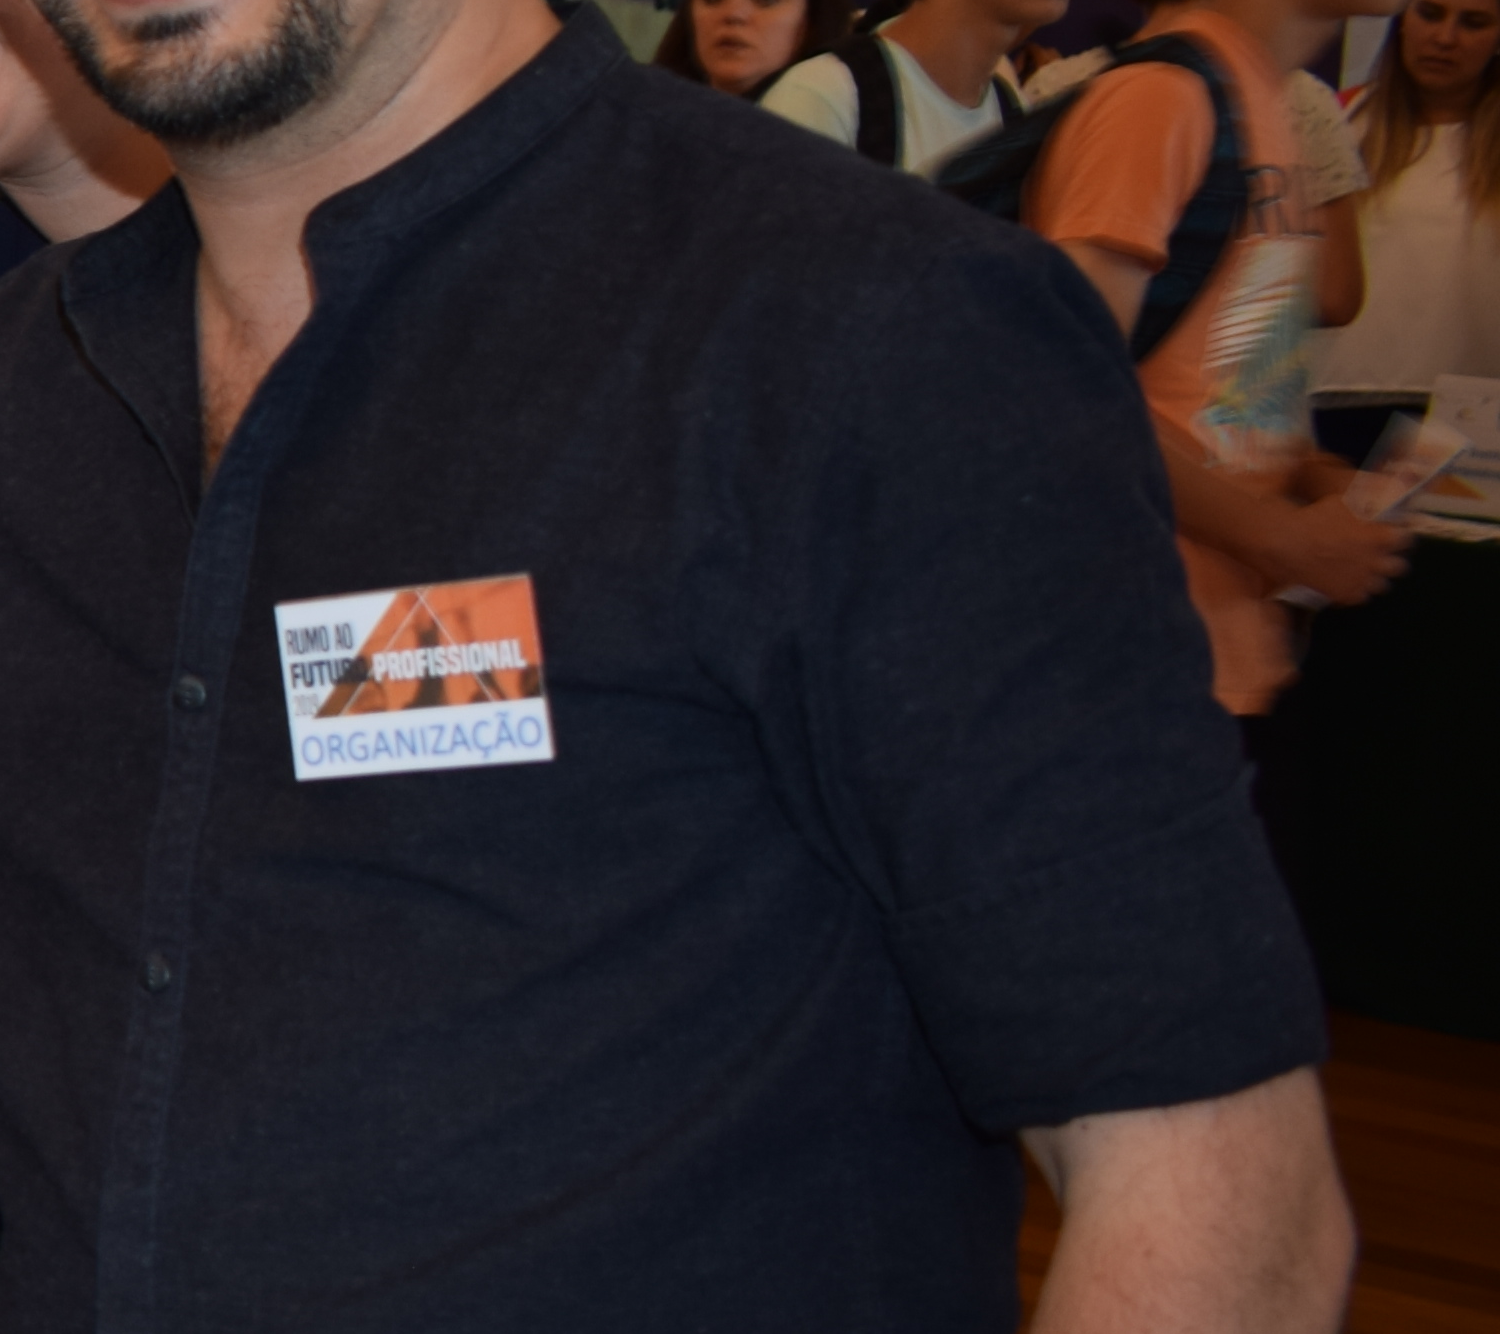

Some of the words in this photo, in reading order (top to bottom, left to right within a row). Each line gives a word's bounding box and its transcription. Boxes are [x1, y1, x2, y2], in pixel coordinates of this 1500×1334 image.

[285, 624, 329, 656] RUMO
[335, 623, 353, 650] AO
[372, 638, 527, 682] PROFISSIONAL
[301, 713, 543, 767] ORGANIZAÇÃO
